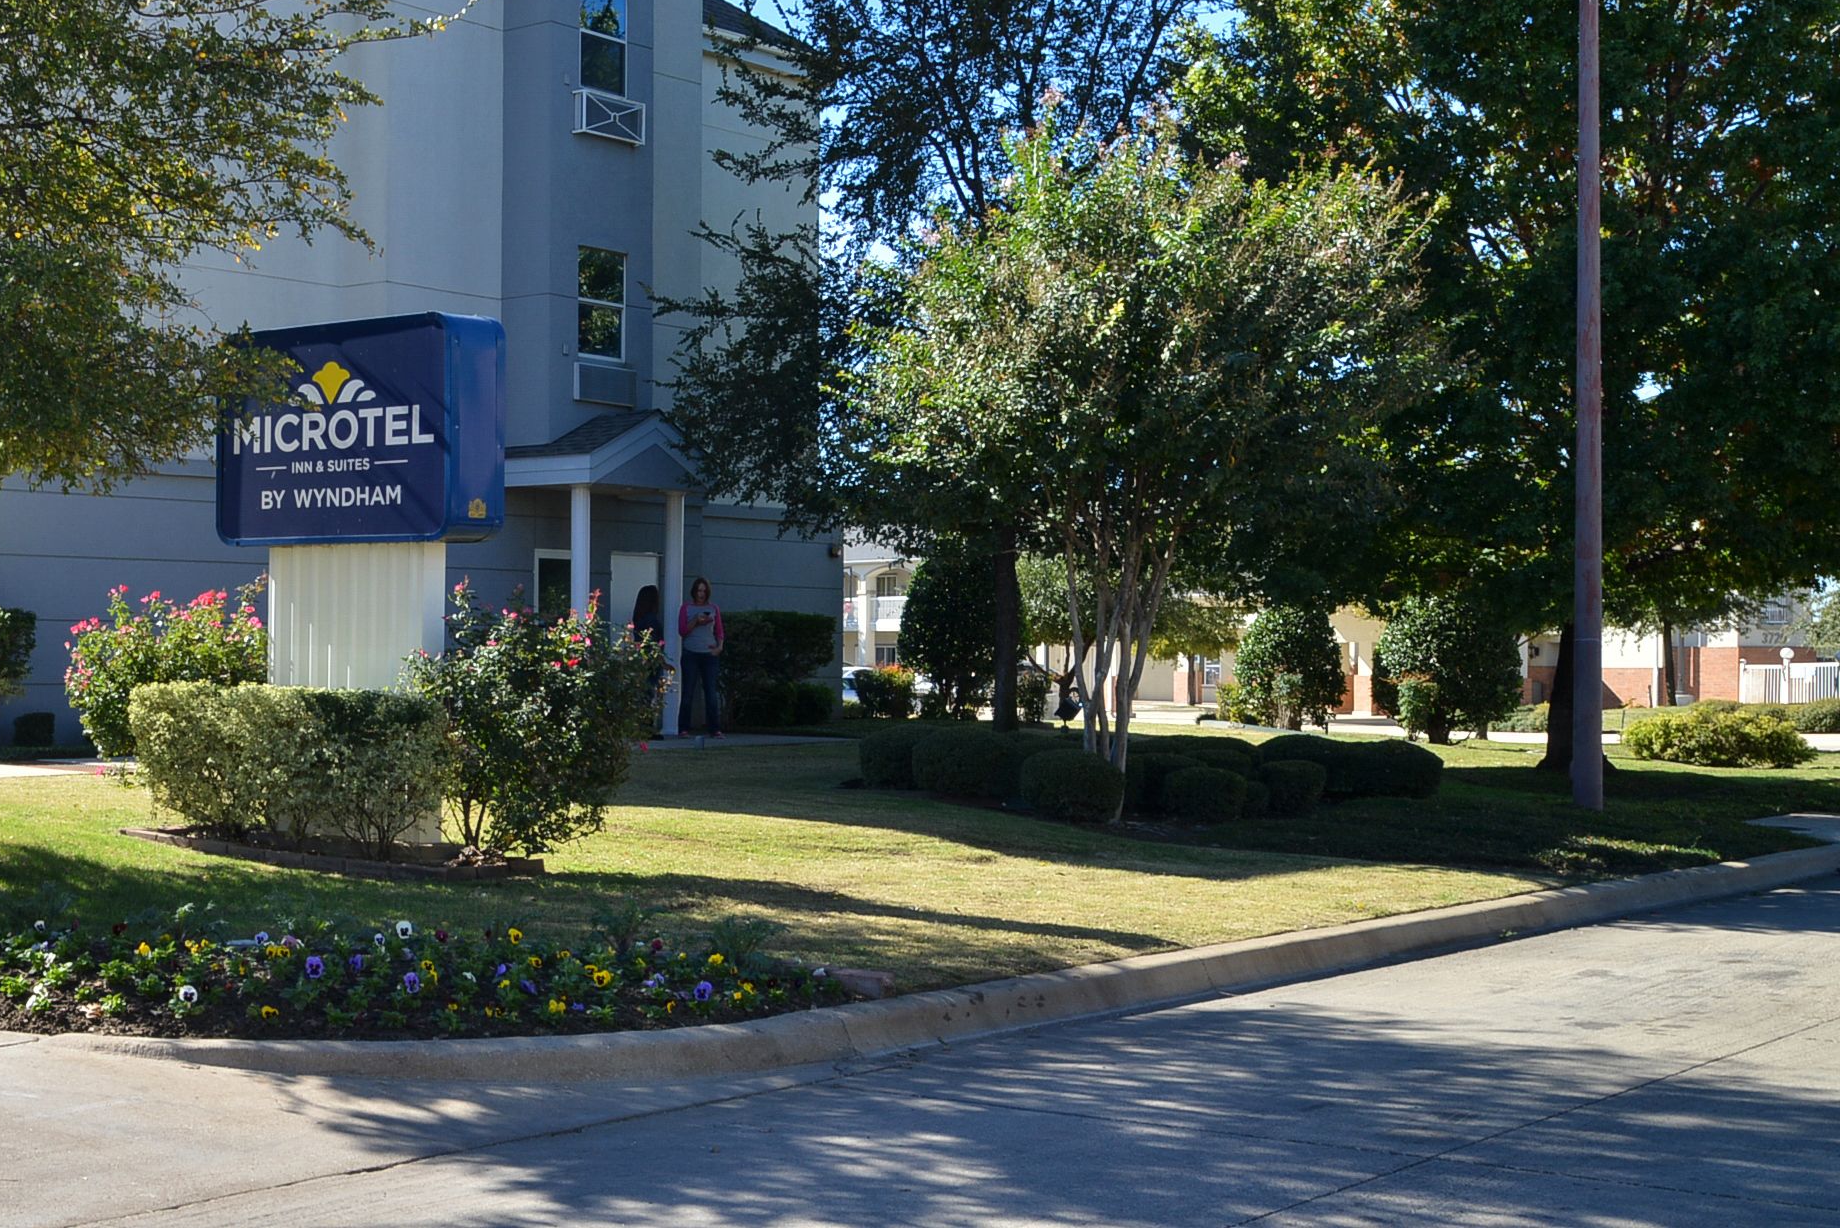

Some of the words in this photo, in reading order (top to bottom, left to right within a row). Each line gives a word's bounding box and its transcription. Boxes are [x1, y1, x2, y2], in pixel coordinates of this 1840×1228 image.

[234, 404, 434, 455] MICROTEL
[291, 461, 312, 474] INN
[316, 461, 324, 473] &
[327, 458, 370, 472] SUITES
[261, 490, 285, 509] BY
[294, 485, 401, 508] WYNDHAM
